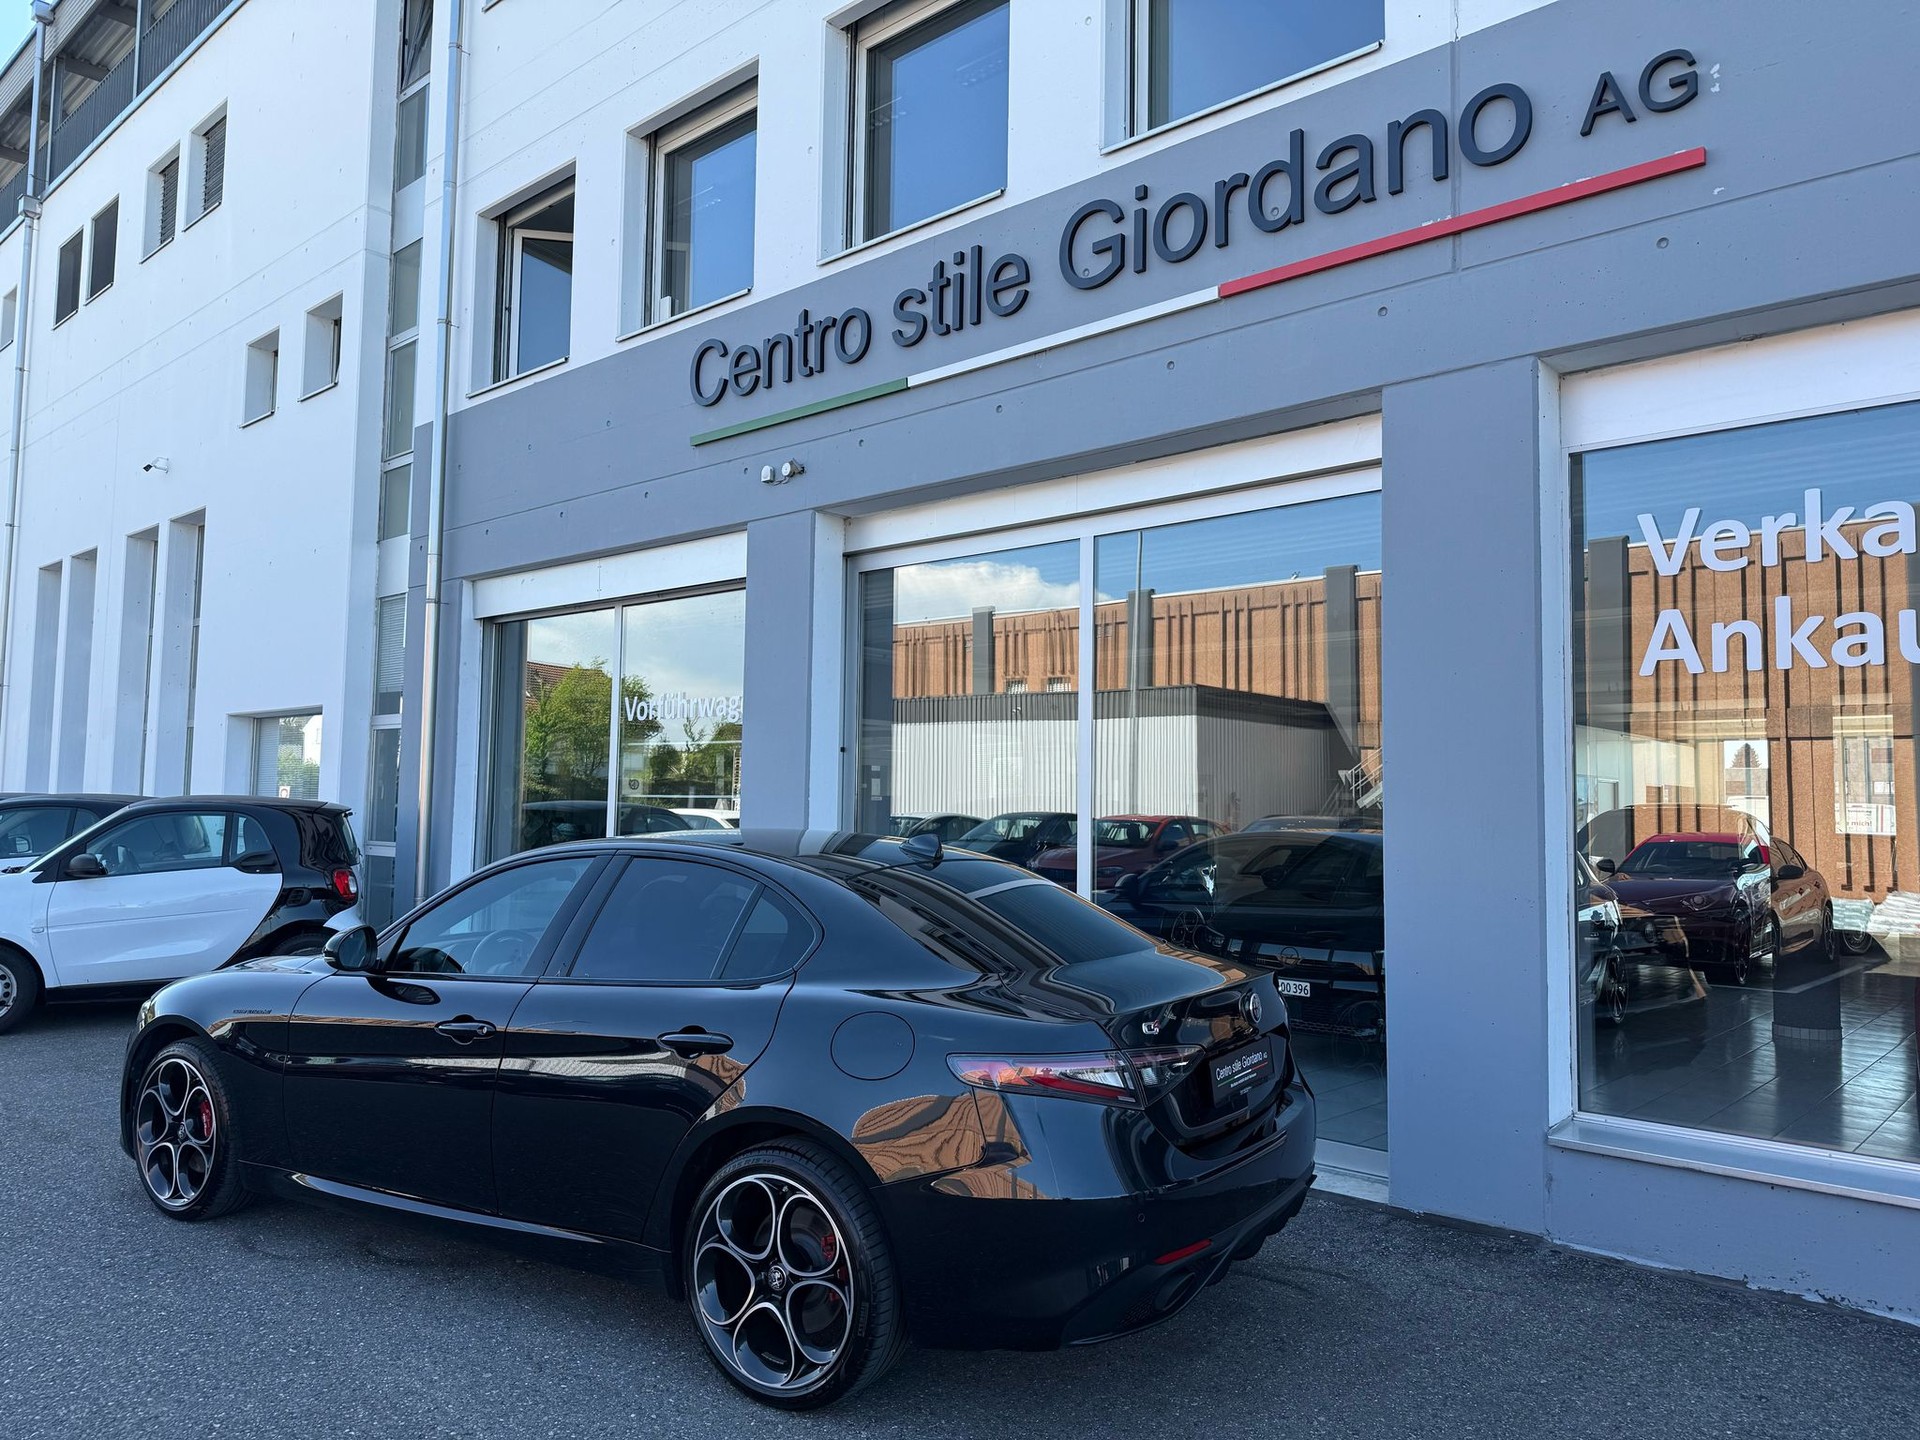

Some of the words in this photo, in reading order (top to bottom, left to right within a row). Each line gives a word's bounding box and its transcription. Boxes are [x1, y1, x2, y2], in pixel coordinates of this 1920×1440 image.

[690, 306, 872, 407] Centro
[891, 244, 1031, 349] stile
[1059, 82, 1533, 291] Giordano
[1580, 48, 1700, 137] AG
[1636, 488, 1917, 577] Verka
[624, 691, 743, 723] Vorführwag
[1292, 983, 1309, 996] 396
